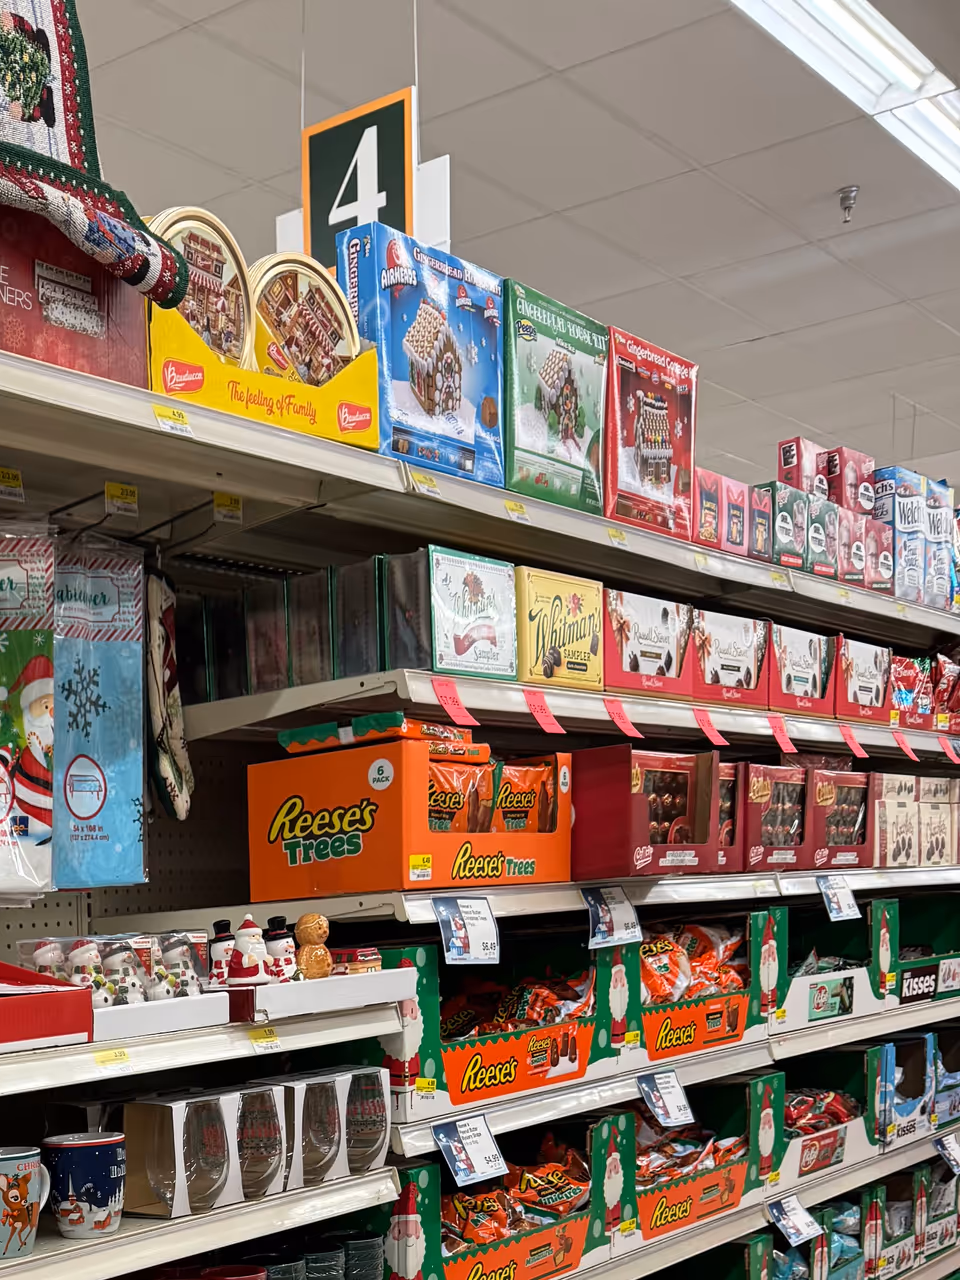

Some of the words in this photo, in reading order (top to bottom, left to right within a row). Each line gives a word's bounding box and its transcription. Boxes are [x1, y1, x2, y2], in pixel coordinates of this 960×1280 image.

[328, 124, 387, 227] 4
[380, 265, 418, 291] AIRHEADS
[626, 339, 665, 367] Gingerbread
[227, 380, 244, 402] The
[245, 390, 274, 415] feeling
[275, 394, 287, 411] of
[286, 393, 318, 424] Family
[528, 594, 602, 668] Whitman's
[473, 644, 500, 665] Sampler
[563, 649, 592, 662] SAMPLER
[372, 776, 390, 784] PACK
[376, 765, 386, 777] 6
[496, 780, 536, 809] Reese's
[72, 825, 80, 833] 54
[87, 824, 97, 833] 108
[268, 796, 379, 844] Reese's
[282, 832, 363, 867] Trees
[452, 841, 506, 880] Reese's
[505, 857, 536, 876] Trees
[481, 941, 497, 952] $6.49
[901, 973, 936, 999] KISSES
[527, 1034, 551, 1054] Reese's
[655, 1015, 697, 1053] Reese's
[460, 1053, 518, 1095] Reese's
[895, 1123, 917, 1139] KISSES
[483, 1153, 501, 1166] $4.99
[649, 1194, 694, 1231] Reese's
